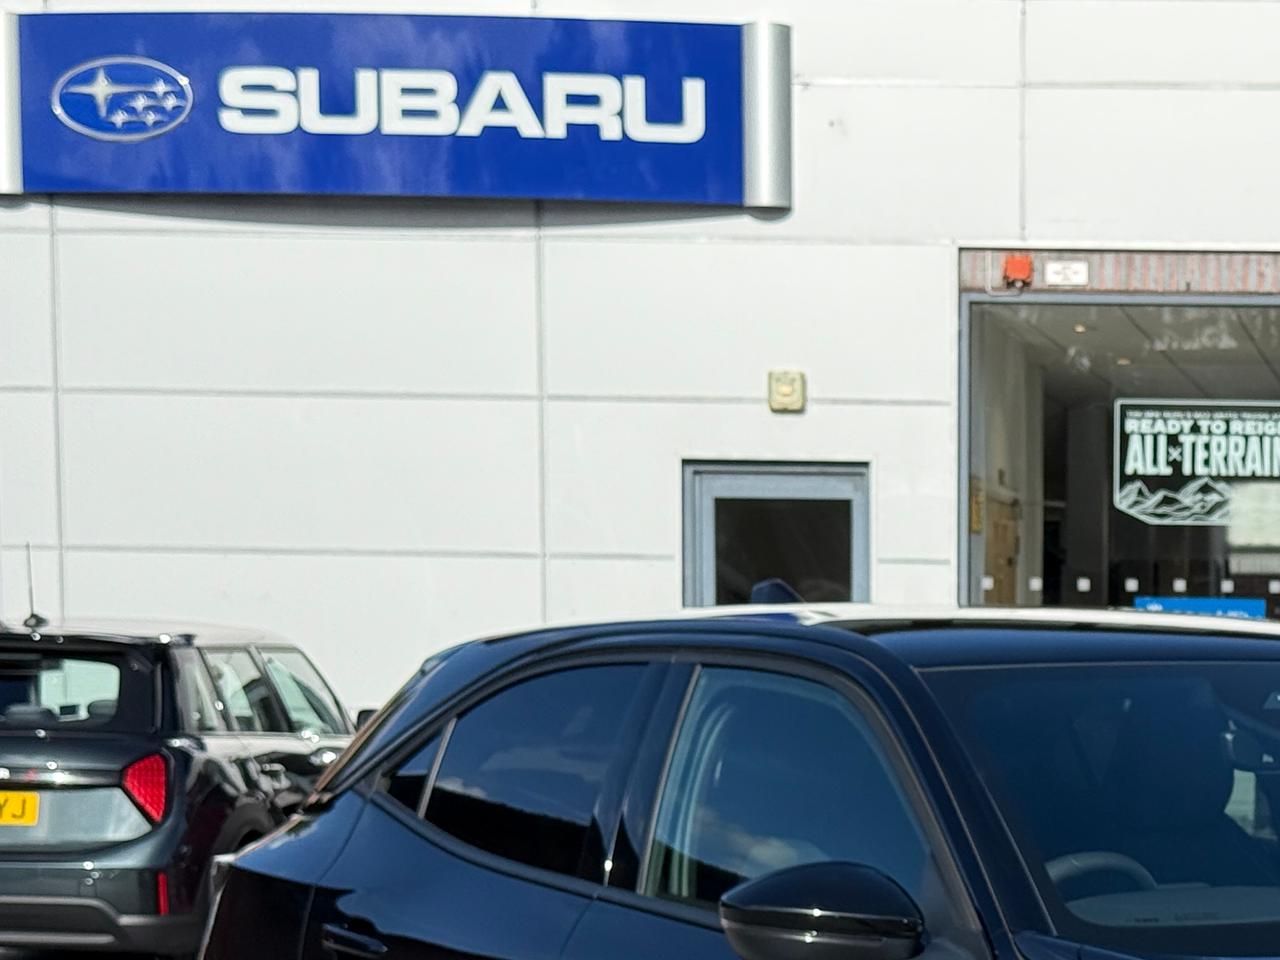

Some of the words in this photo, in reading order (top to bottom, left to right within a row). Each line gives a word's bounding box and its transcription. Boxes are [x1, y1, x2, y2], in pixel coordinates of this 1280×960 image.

[219, 66, 706, 143] SUBARU
[1125, 418, 1195, 434] READY
[1200, 419, 1228, 434] TO
